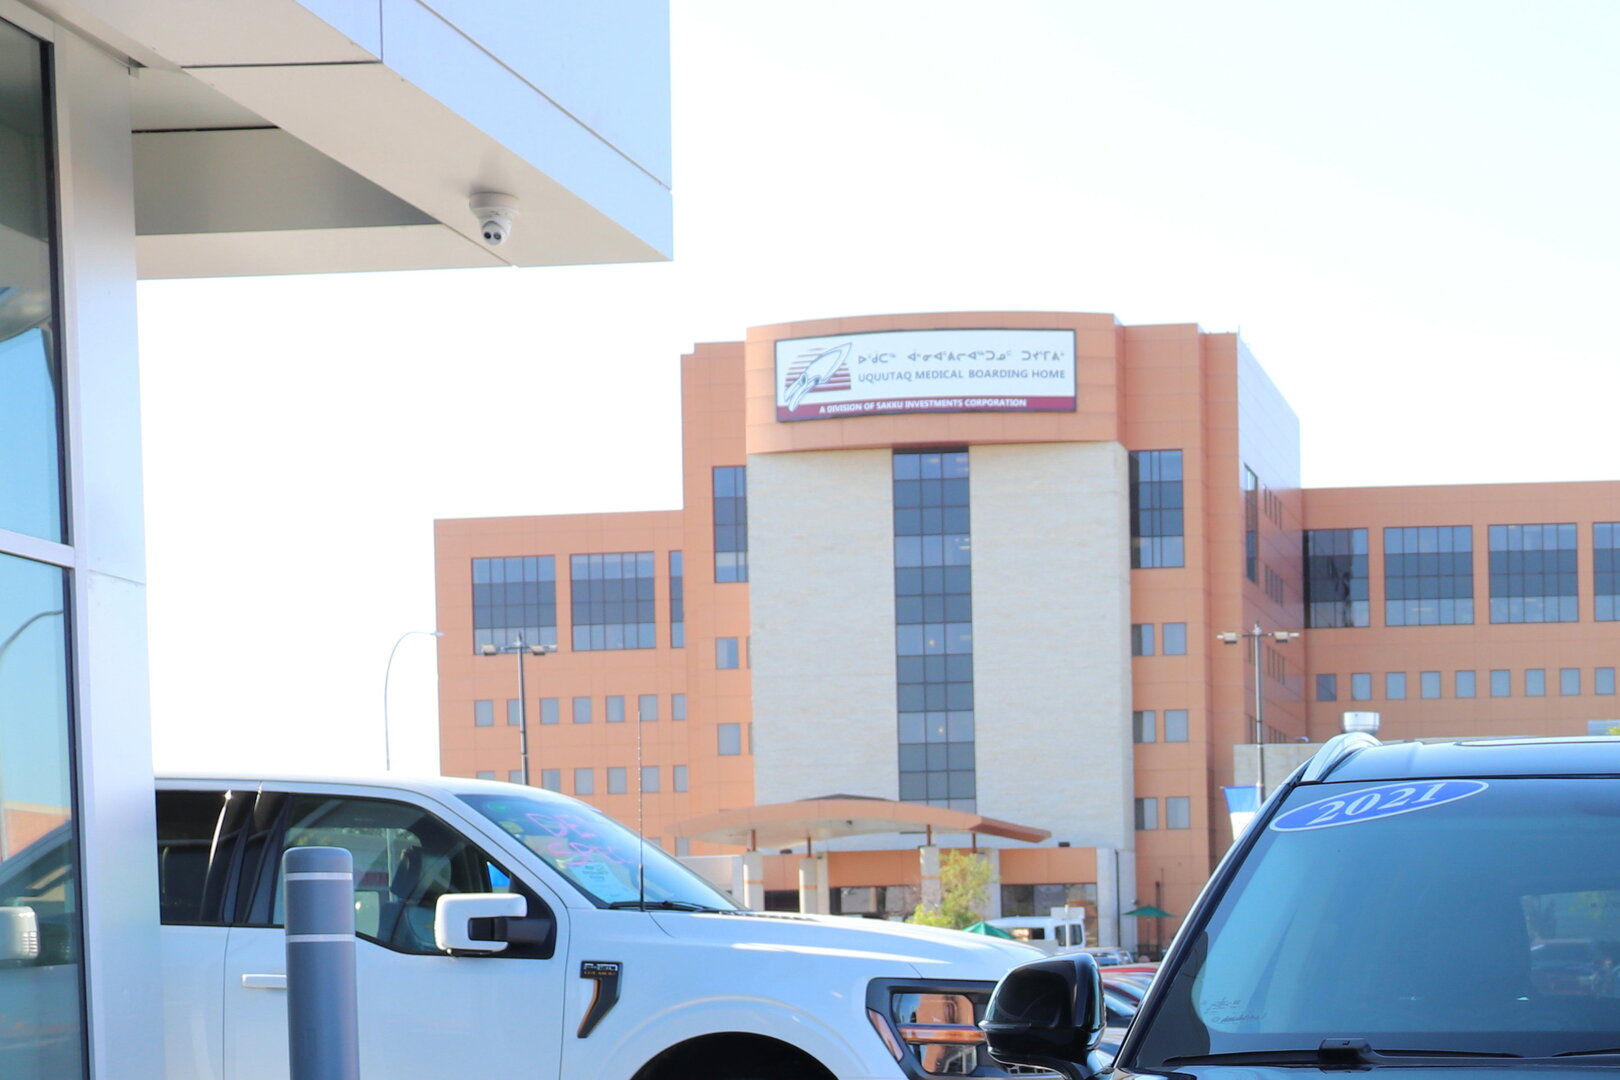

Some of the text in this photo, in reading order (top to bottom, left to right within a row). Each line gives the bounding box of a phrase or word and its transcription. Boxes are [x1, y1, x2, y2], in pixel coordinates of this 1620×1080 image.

[858, 368, 1066, 384] UQUUTAQ MEDICAL BOARDING HOME
[819, 398, 1028, 414] A DIVISION OF SAKKU INVESTMENTS CORPORATION
[1305, 782, 1448, 826] 2021
